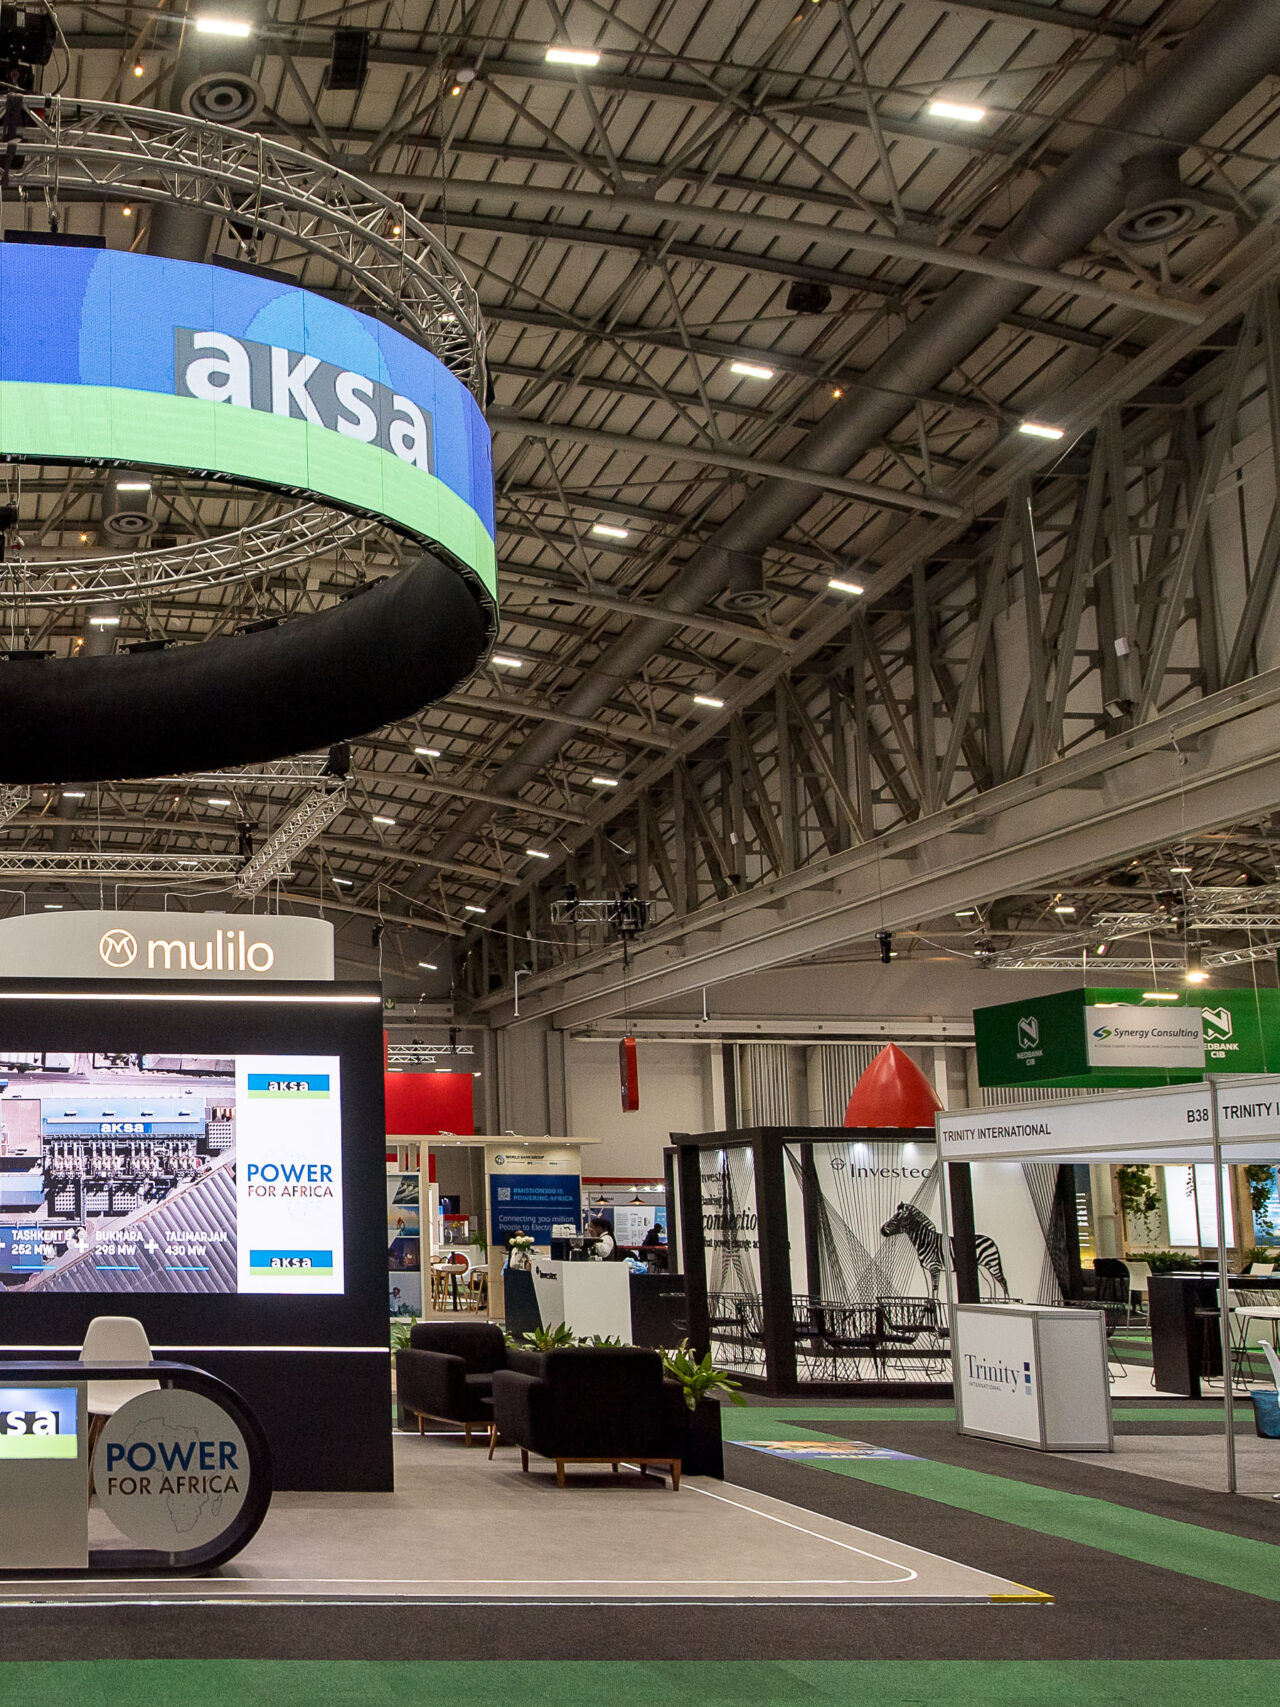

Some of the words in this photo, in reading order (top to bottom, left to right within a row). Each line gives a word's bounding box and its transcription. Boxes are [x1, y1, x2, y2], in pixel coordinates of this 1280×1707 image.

[184, 330, 430, 471] aksa
[148, 930, 274, 973] mulilo
[1114, 1028, 1149, 1039] Synergy
[1151, 1028, 1199, 1039] Consulting
[1017, 1050, 1043, 1059] NEDBANK
[1211, 1050, 1226, 1059] CIB
[269, 1081, 309, 1092] aksa
[1187, 1109, 1209, 1122] B38
[1223, 1102, 1272, 1119] TRINITY
[101, 1123, 145, 1134] aksa
[943, 1129, 975, 1141] TRINITY
[978, 1123, 1051, 1139] INTERNATIONAL
[248, 1164, 333, 1183] POWER
[850, 1164, 931, 1178] Investec
[249, 1185, 276, 1197] FOR
[281, 1185, 333, 1197] AFRICA
[498, 1215, 536, 1223] Connecting
[703, 1206, 758, 1231] connctio
[499, 1224, 520, 1232] People
[11, 1230, 60, 1241] TASHKENT
[96, 1231, 143, 1242] BUKHARA
[165, 1231, 227, 1242] TALIMARJAN
[12, 1244, 32, 1255] 252
[35, 1244, 54, 1255] MW
[96, 1245, 115, 1256] 298
[119, 1245, 136, 1255] MW
[165, 1245, 185, 1256] 430
[188, 1246, 206, 1256] MW
[271, 1257, 311, 1268] aksa
[964, 1354, 1020, 1393] Trinity
[107, 1441, 239, 1471] POWER
[108, 1476, 152, 1496] FOR
[159, 1475, 239, 1494] AFRICA
